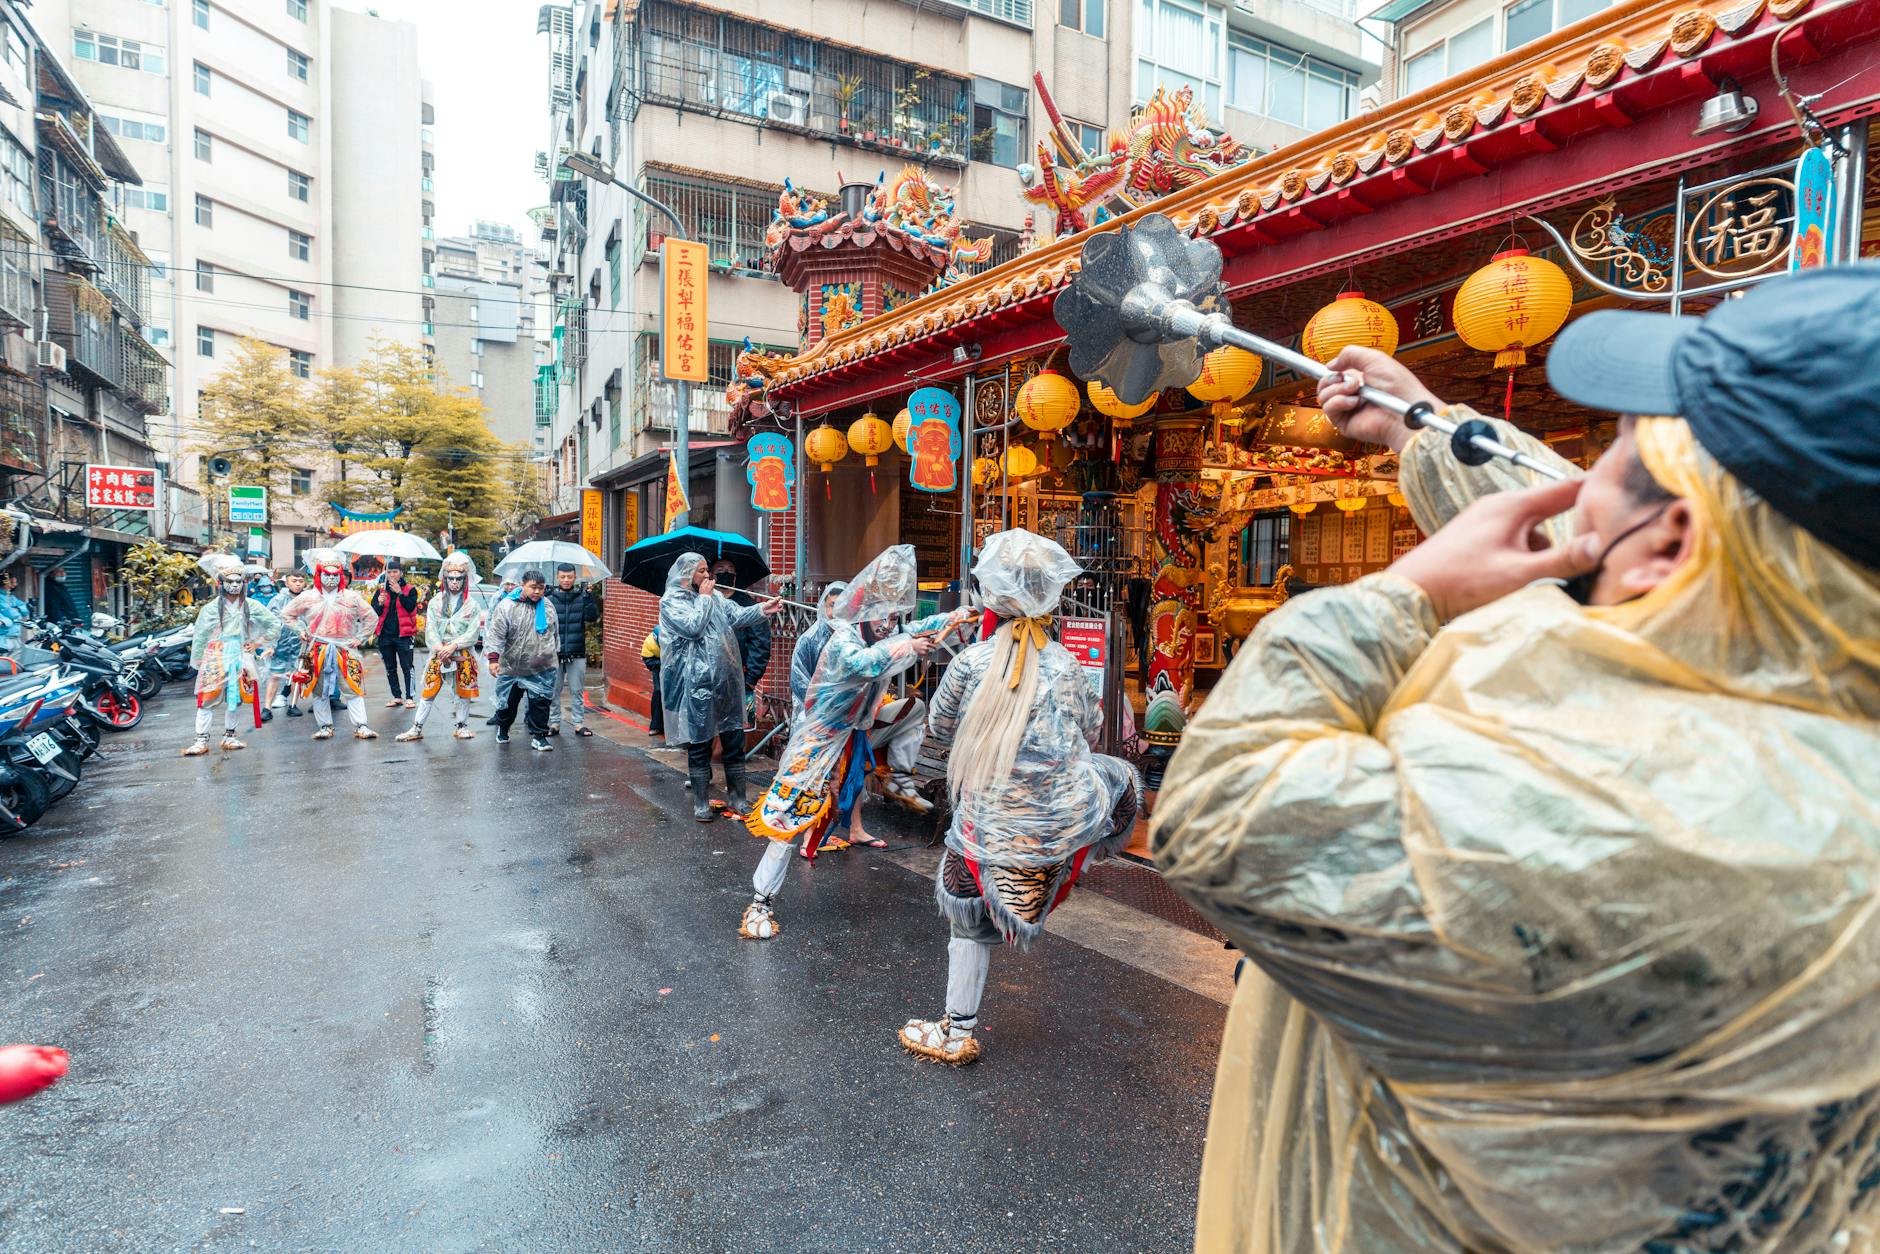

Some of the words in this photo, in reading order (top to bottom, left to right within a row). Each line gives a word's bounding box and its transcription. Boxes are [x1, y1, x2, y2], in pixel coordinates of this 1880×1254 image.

[1705, 189, 1784, 264] 福
[676, 248, 695, 373] 三張犁福佑宮
[1360, 301, 1385, 349] 福德正
[1502, 261, 1530, 332] 福德正神
[915, 402, 954, 418] 福佑宮
[91, 470, 136, 488] 牛肉麵
